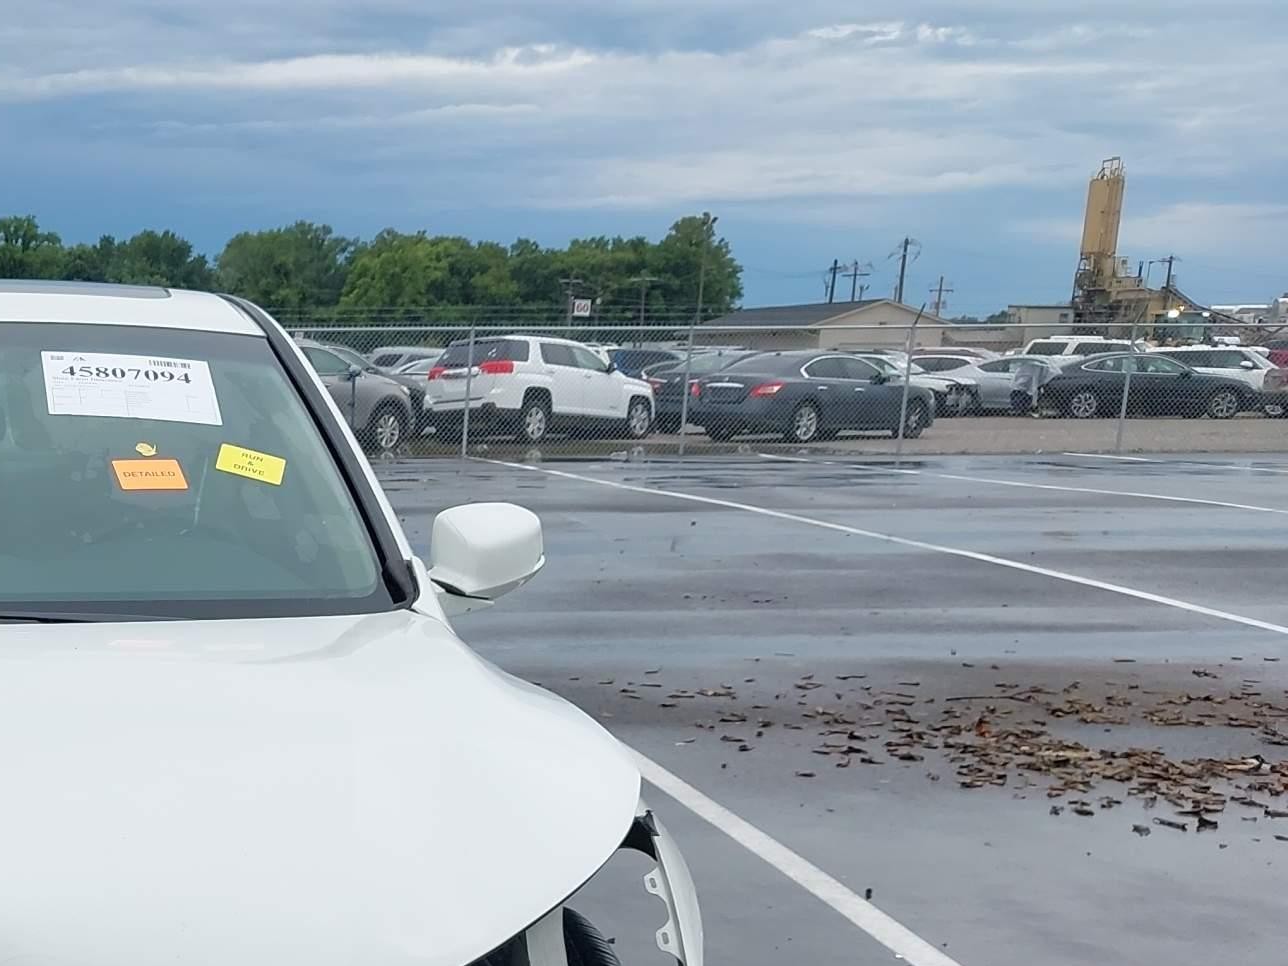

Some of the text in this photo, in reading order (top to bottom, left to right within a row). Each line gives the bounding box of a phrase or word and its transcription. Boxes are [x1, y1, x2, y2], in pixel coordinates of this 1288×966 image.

[61, 365, 192, 384] 45807094
[241, 452, 264, 463] RUN
[122, 470, 176, 478] DETAILED
[233, 463, 265, 476] DRIVE
